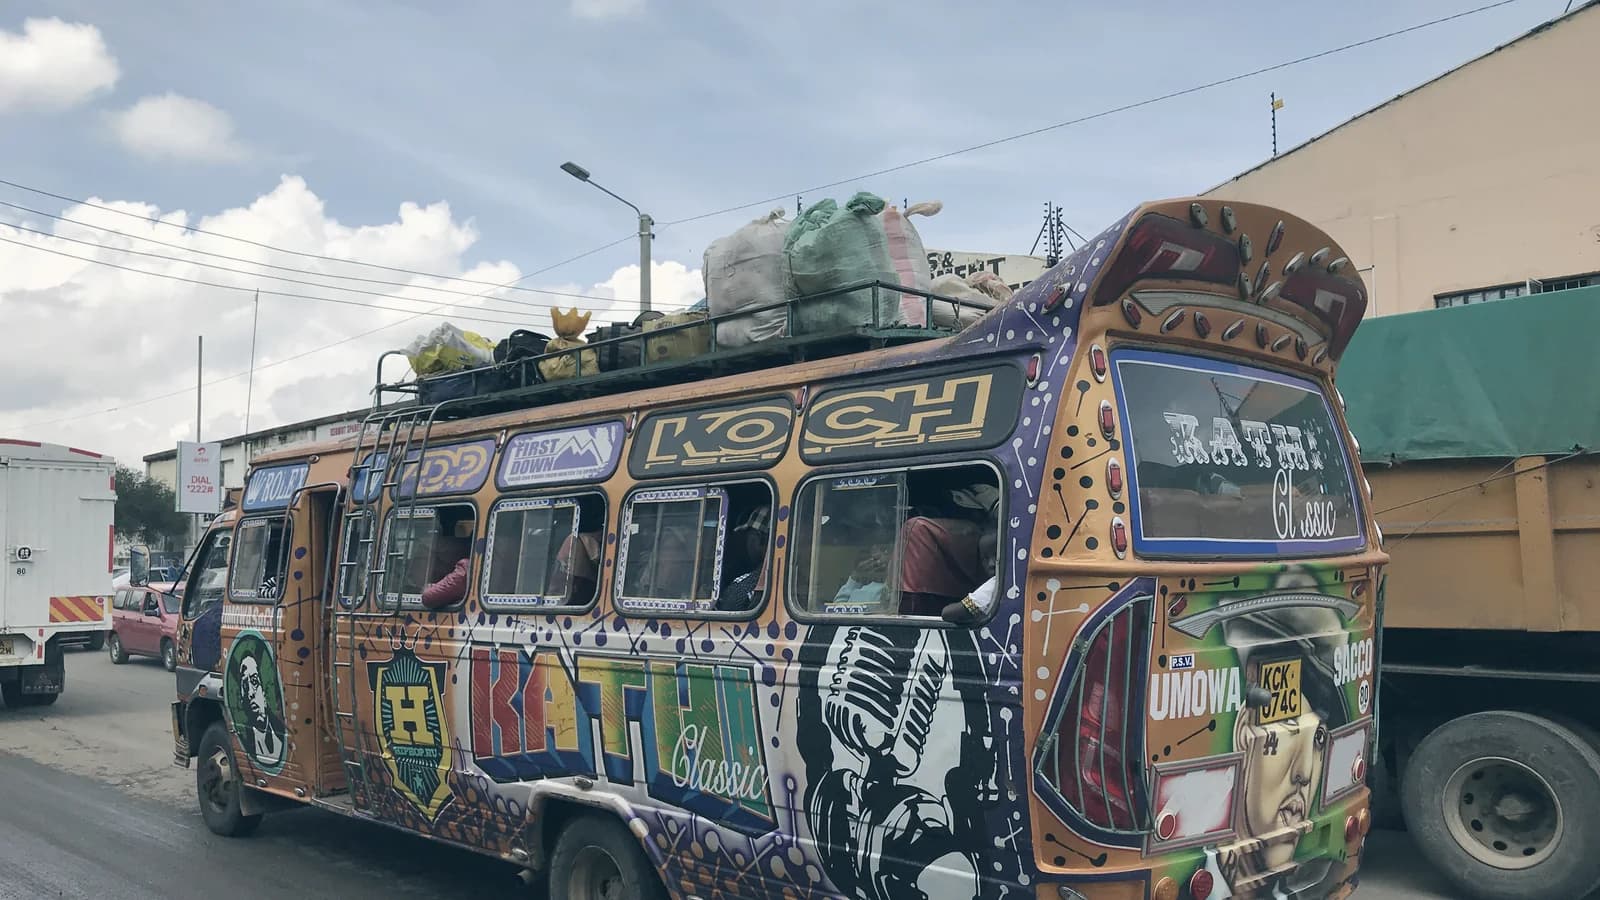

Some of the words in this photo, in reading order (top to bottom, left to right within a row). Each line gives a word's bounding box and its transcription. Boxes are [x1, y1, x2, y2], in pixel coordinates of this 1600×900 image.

[942, 252, 954, 268] &
[514, 438, 560, 458] FIRST
[510, 457, 557, 476] DOWN
[192, 475, 212, 484] DIAL
[17, 567, 26, 575] 80
[1172, 656, 1192, 668] P.S.V.
[1150, 667, 1241, 720] UMOWA
[1333, 637, 1373, 687] SACCO
[1263, 664, 1290, 690] KCK
[385, 686, 435, 744] H
[671, 724, 769, 800] Classic
